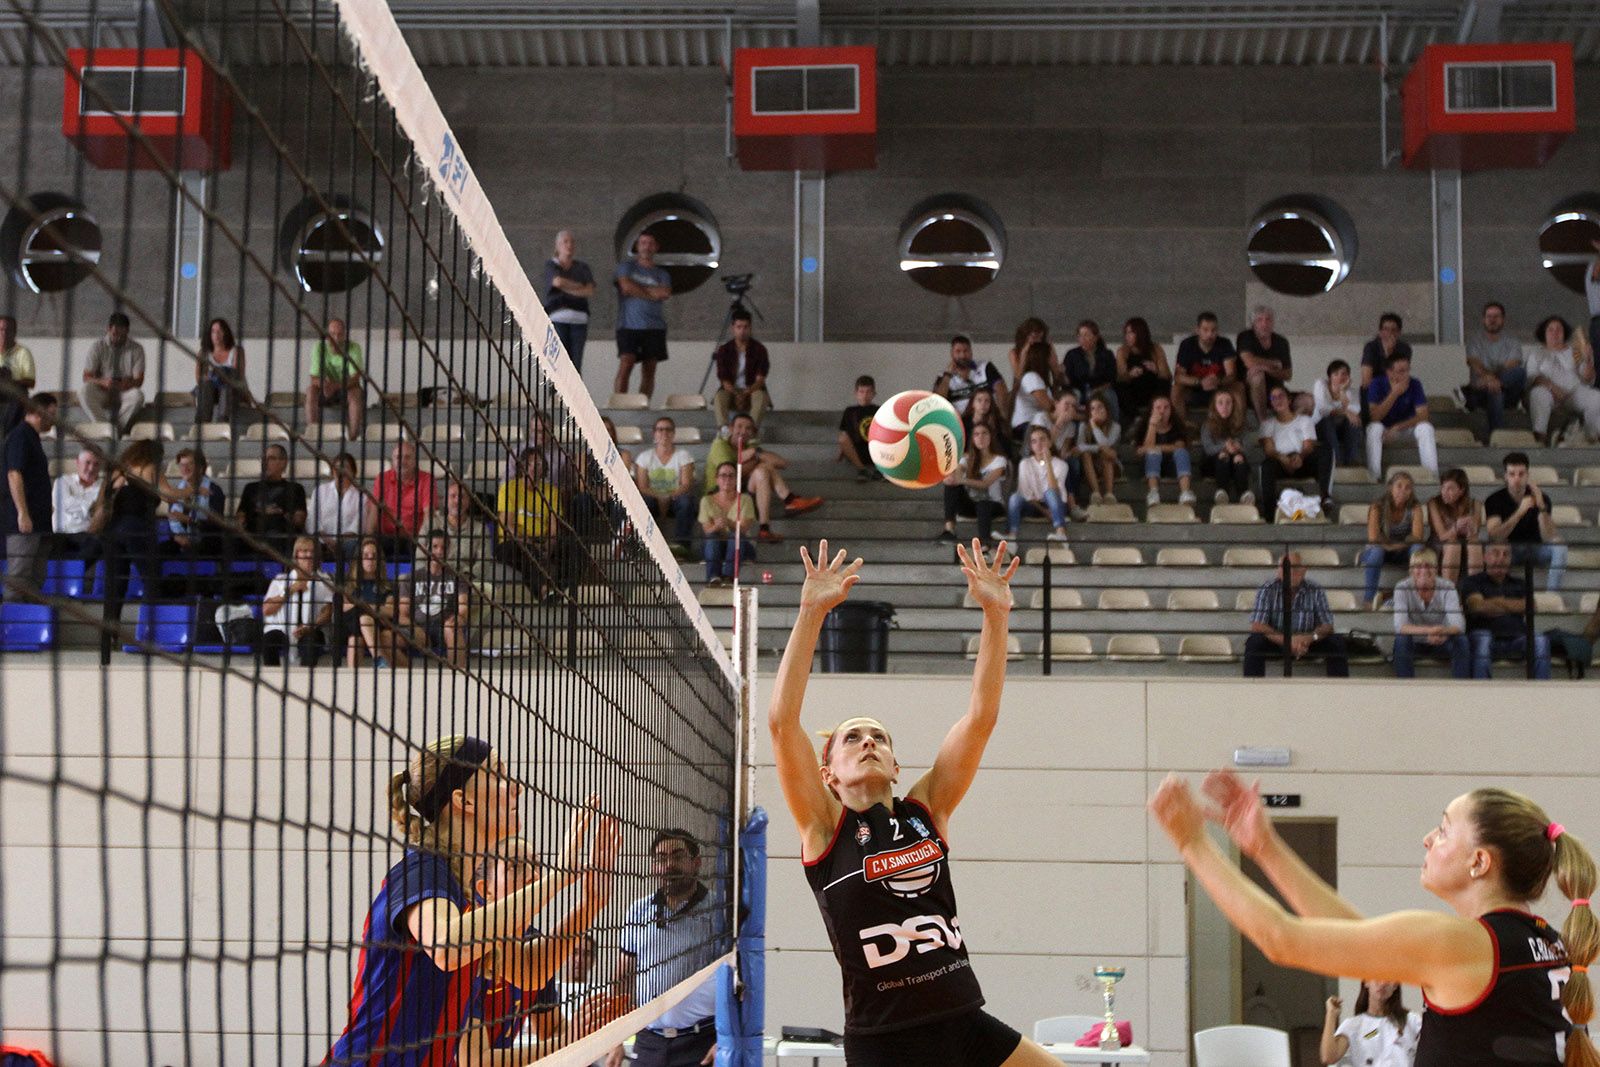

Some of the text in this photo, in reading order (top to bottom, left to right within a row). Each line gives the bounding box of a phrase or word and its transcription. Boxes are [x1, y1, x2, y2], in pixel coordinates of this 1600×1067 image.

[889, 817, 904, 841] 2
[872, 844, 938, 874] C.V.SANTCUGA
[876, 979, 904, 992] Global
[905, 965, 948, 986] Transport
